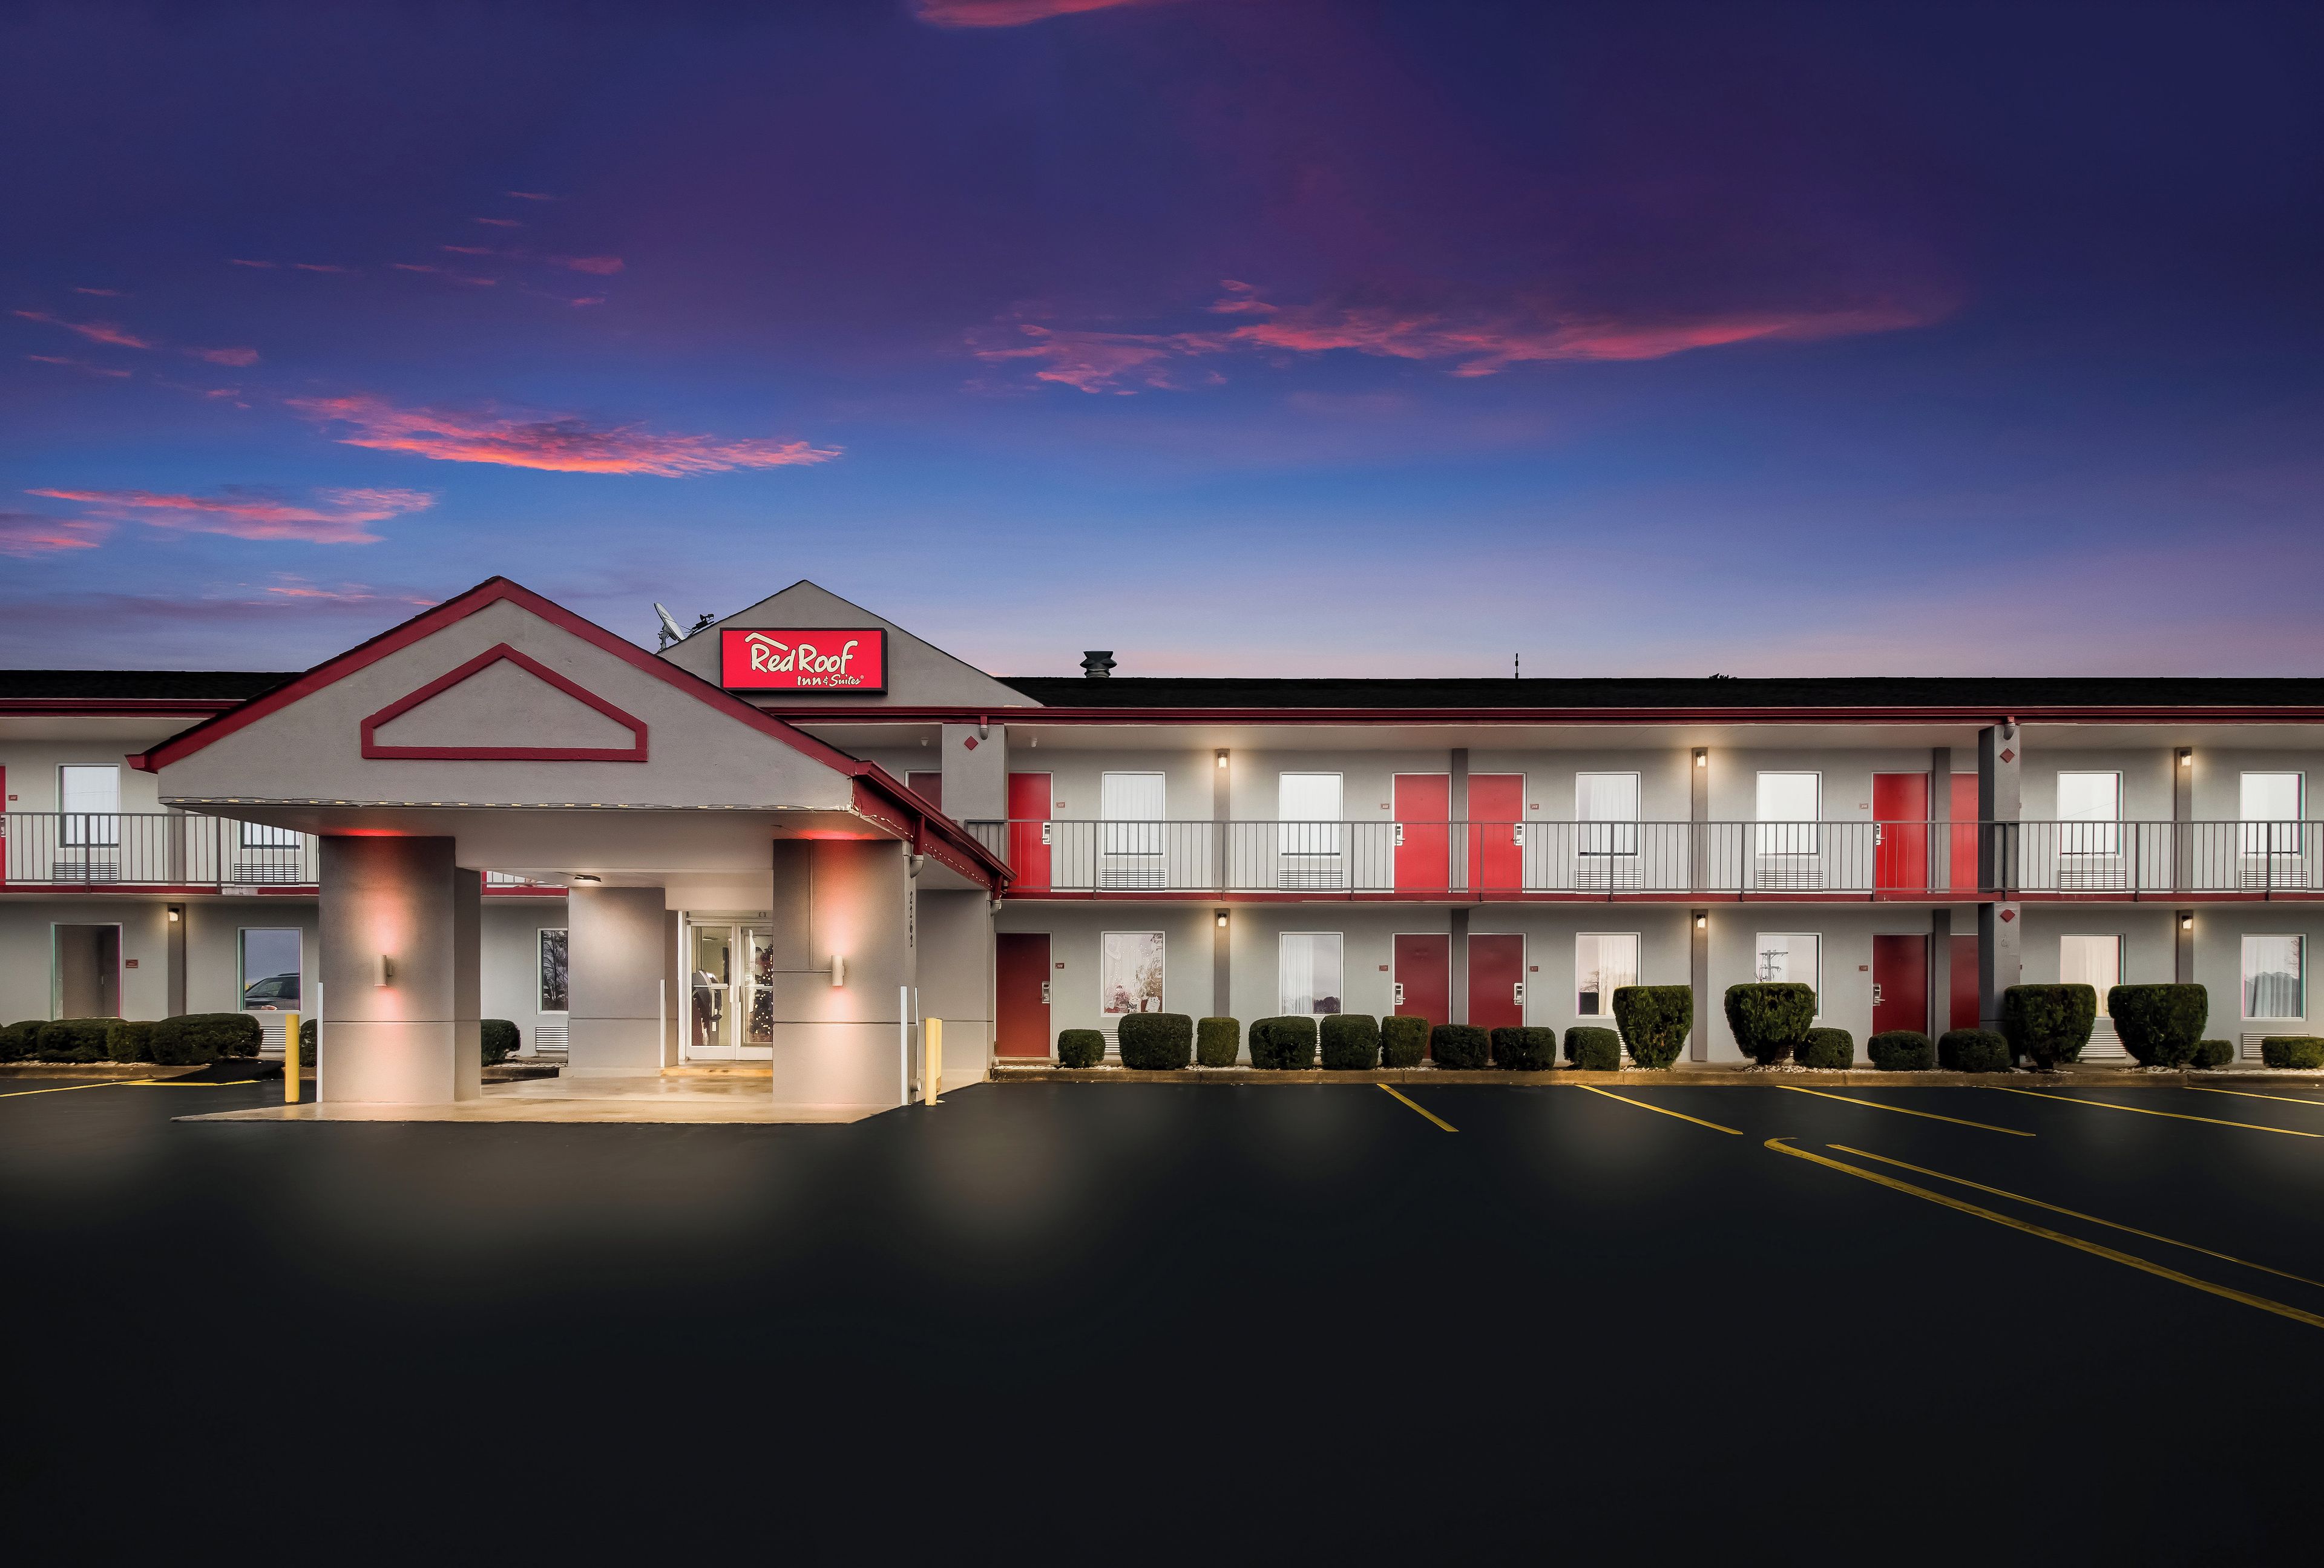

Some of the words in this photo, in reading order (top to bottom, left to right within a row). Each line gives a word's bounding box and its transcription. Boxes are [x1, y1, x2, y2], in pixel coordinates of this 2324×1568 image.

[751, 643, 796, 673] Red
[798, 640, 858, 674] Roof
[797, 675, 822, 686] Inn
[823, 675, 829, 686] &
[829, 674, 861, 687] Suites
